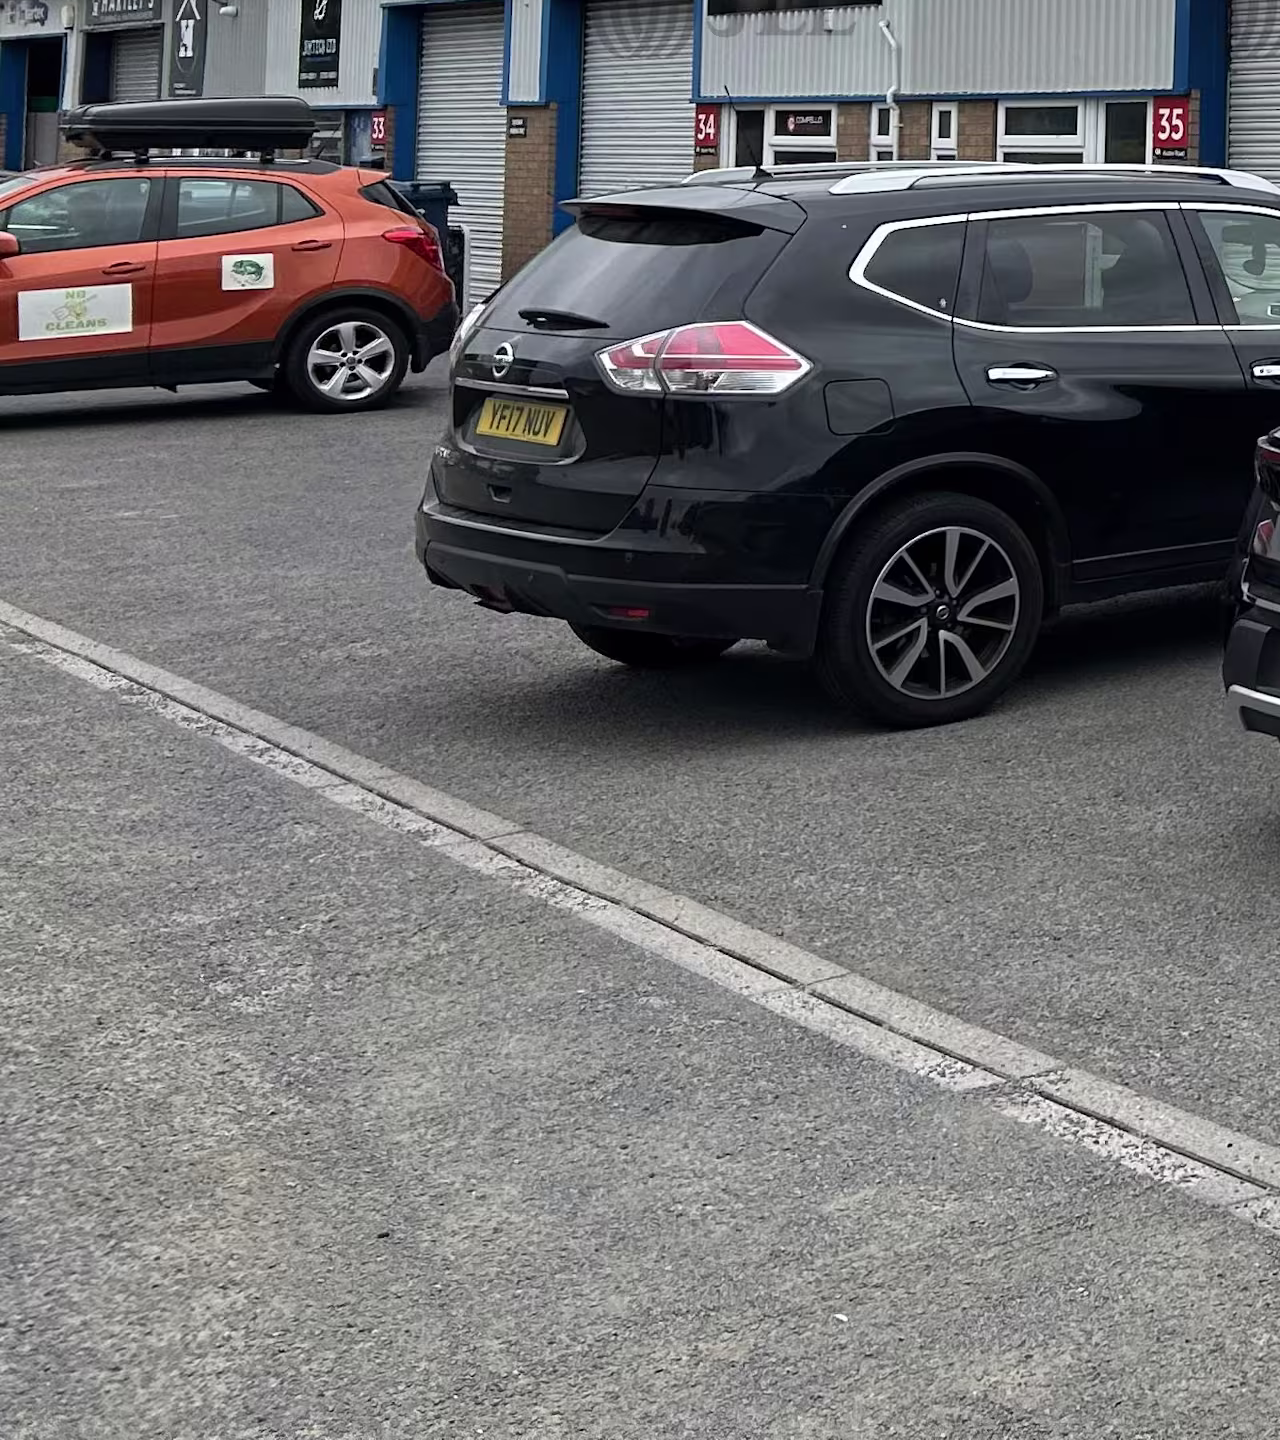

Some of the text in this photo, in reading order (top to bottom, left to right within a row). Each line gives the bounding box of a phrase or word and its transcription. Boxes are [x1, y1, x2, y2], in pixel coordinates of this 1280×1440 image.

[372, 117, 385, 139] 33
[697, 114, 715, 140] 34
[1158, 108, 1184, 140] 35
[45, 318, 107, 332] CLEANS
[489, 401, 556, 439] YF17 NUV
